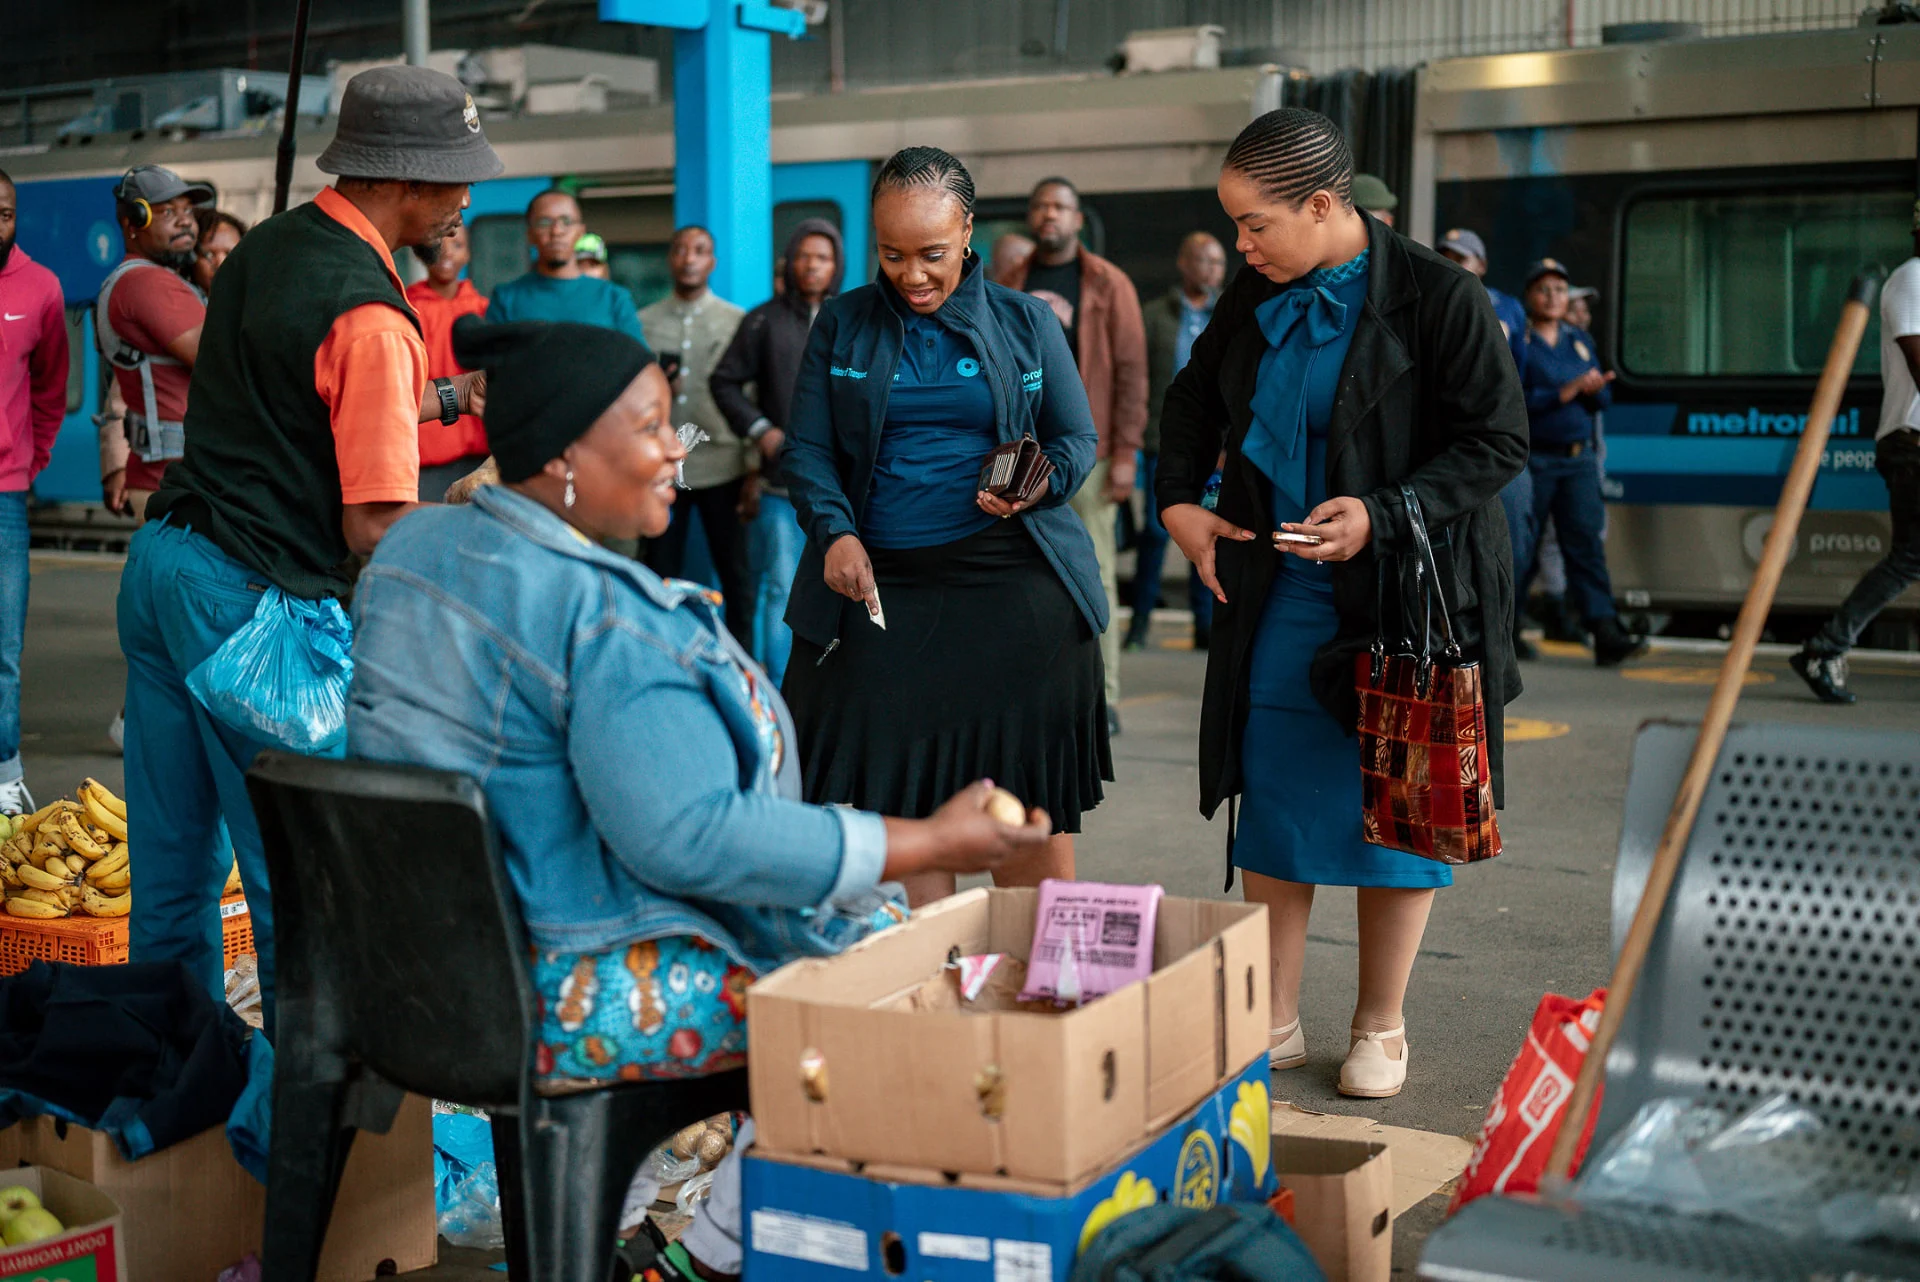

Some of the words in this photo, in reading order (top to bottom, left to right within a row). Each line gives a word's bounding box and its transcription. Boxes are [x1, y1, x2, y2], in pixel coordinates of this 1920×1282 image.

[1687, 407, 1859, 434] metroril
[1833, 450, 1876, 471] peop
[1810, 533, 1882, 553] prasa
